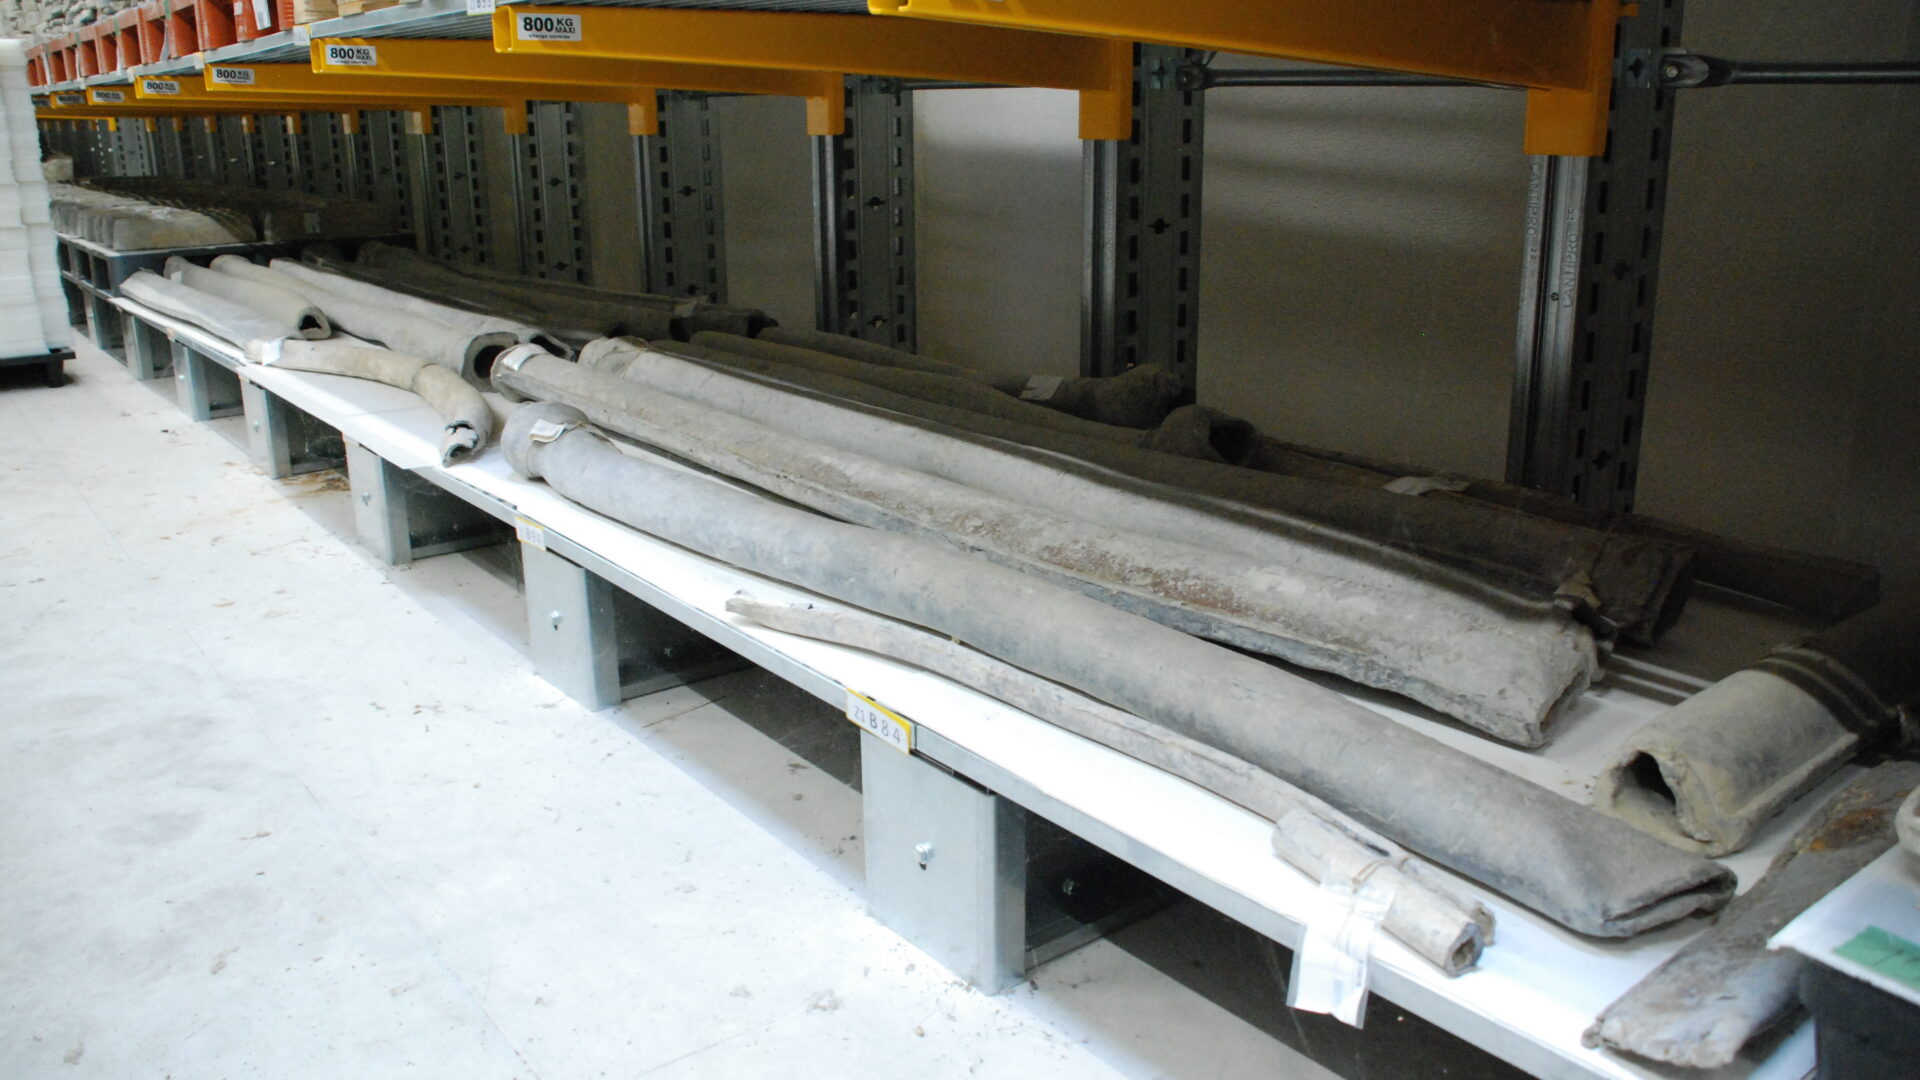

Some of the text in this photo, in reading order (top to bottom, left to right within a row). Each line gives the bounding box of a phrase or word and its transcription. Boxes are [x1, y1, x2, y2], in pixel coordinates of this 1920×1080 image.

[523, 16, 574, 32] 800 KG
[555, 26, 576, 34] MAXI
[330, 47, 370, 59] 800 KG
[216, 68, 237, 79] 800
